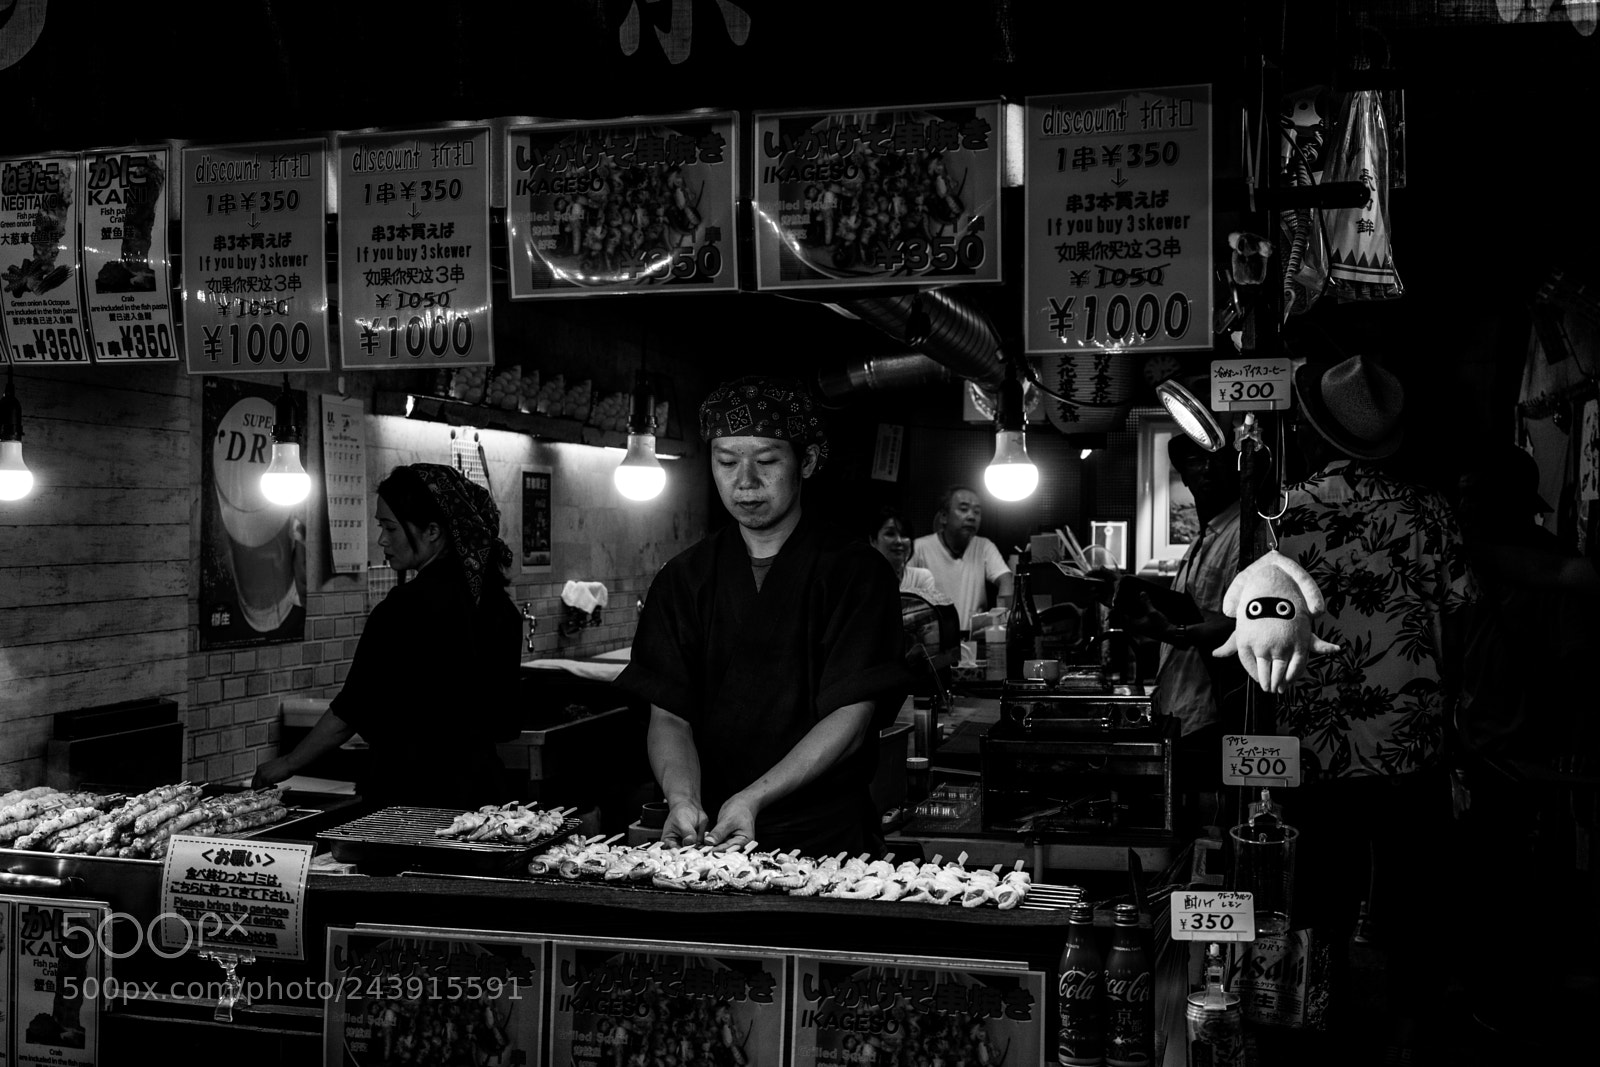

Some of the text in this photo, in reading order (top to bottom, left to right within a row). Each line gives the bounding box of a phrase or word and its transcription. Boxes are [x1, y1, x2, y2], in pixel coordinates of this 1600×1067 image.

[1043, 99, 1193, 134] discount 折扣
[353, 141, 473, 171] discount 折扣
[2, 161, 59, 195] ねぎたこ
[88, 155, 148, 189] かに
[196, 152, 310, 183] discount 折扣
[763, 163, 858, 184] IKAGESO
[516, 175, 604, 196] IKAGESO
[17, 212, 28, 220] Fish
[101, 208, 114, 216] Fish
[1067, 219, 1092, 236] you
[1097, 216, 1123, 235] buy
[1127, 215, 1134, 232] 3
[1138, 213, 1190, 231] skewer
[214, 257, 234, 271] you
[237, 254, 257, 271] buy
[260, 254, 266, 269] 3
[269, 252, 308, 268] skewer
[373, 247, 393, 262] you
[397, 245, 417, 262] buy
[421, 244, 427, 260] 3
[430, 243, 471, 258] skewer
[875, 234, 985, 270] ¥350
[1220, 382, 1274, 400] ¥300
[243, 413, 272, 429] SUPE
[1231, 757, 1286, 775] ¥500
[174, 897, 205, 908] Please
[207, 900, 231, 912] bring
[233, 902, 248, 911] the
[1180, 913, 1234, 930] ¥350
[559, 995, 650, 1018] IKAGESO
[802, 1010, 899, 1034] IKAGESO
